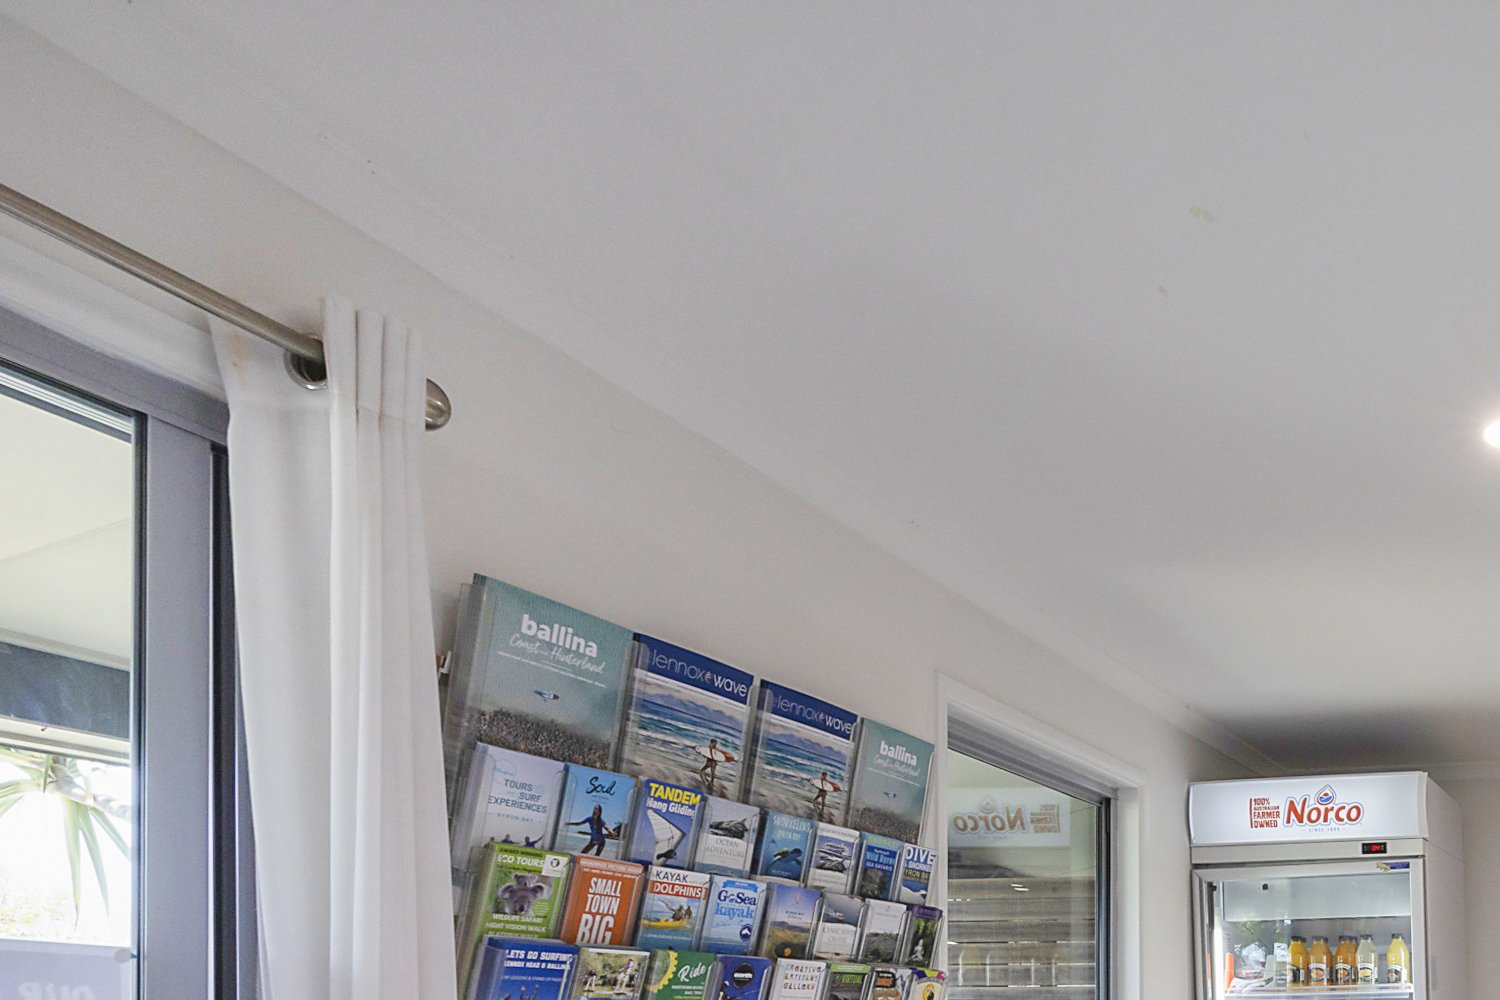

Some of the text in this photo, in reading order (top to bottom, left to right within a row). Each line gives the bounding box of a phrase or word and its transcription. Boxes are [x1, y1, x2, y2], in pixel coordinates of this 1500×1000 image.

[521, 613, 598, 658] ballina
[652, 649, 747, 698] lennox wave
[778, 697, 851, 735] lennox wave
[879, 740, 918, 766] ballina
[504, 779, 533, 792] TOURS
[649, 782, 702, 806] TANDEM
[487, 795, 548, 814] EXPERIENCES
[519, 792, 543, 803] SURF
[1253, 797, 1271, 806] 100%
[646, 797, 696, 818] Hang Gliding
[1253, 811, 1281, 820] FARMER
[1285, 797, 1362, 825] Norco
[1253, 820, 1278, 829] OWNED
[497, 854, 544, 867] ECO TOURS
[906, 846, 936, 865] DIVE
[655, 869, 689, 884] KAYAK
[589, 877, 623, 897] SMALL
[653, 882, 706, 900] DOLPHINS!
[585, 893, 621, 915] TOWN
[715, 903, 755, 920] kayak
[575, 913, 615, 946] BIG
[505, 949, 526, 959] LETS
[526, 950, 539, 960] GO
[526, 961, 541, 969] HEAD
